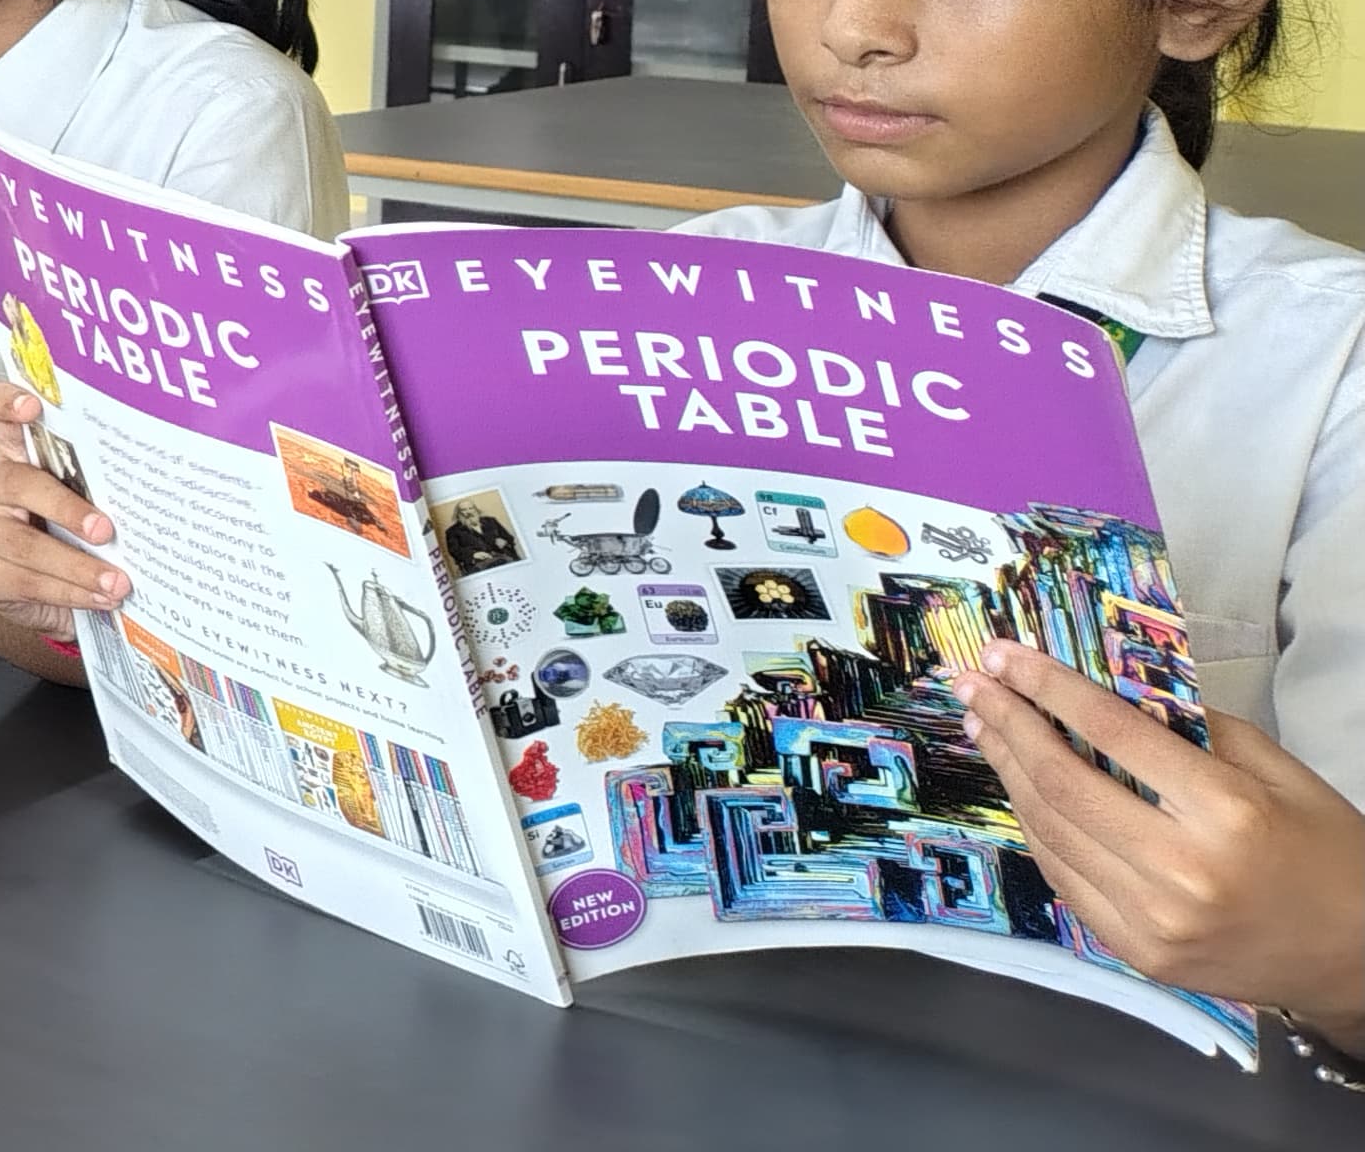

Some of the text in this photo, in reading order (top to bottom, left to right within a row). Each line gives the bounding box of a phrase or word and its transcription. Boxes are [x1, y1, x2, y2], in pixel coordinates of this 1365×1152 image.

[12, 236, 261, 370] PERIODIC
[370, 259, 1096, 379] DK EYEWITNESS
[60, 307, 218, 409] TABLE
[520, 328, 972, 421] PERIODIC
[349, 280, 418, 483] EYEWITNESS
[617, 383, 896, 458] TABLE
[763, 505, 778, 517] Cf
[187, 538, 236, 564] explore
[241, 560, 256, 571] all
[261, 564, 286, 581] the
[192, 520, 254, 553] antimony
[258, 543, 276, 557] to
[172, 550, 225, 581] building
[227, 572, 273, 596] blocks
[277, 591, 292, 603] of
[184, 593, 213, 611] ways
[217, 608, 233, 620] we
[238, 616, 261, 631] use
[197, 581, 221, 596] and
[224, 589, 247, 607] the
[252, 601, 290, 624] many
[645, 599, 663, 609] Eu
[428, 547, 488, 721] PERIODIC TABLE
[159, 602, 192, 629] YOU
[201, 624, 328, 685] EYEWITNESS
[340, 680, 409, 715] NEXT?
[527, 829, 540, 841] Si
[271, 855, 296, 878] DK
[559, 900, 636, 931] EDITION
[572, 890, 614, 911] NEW
